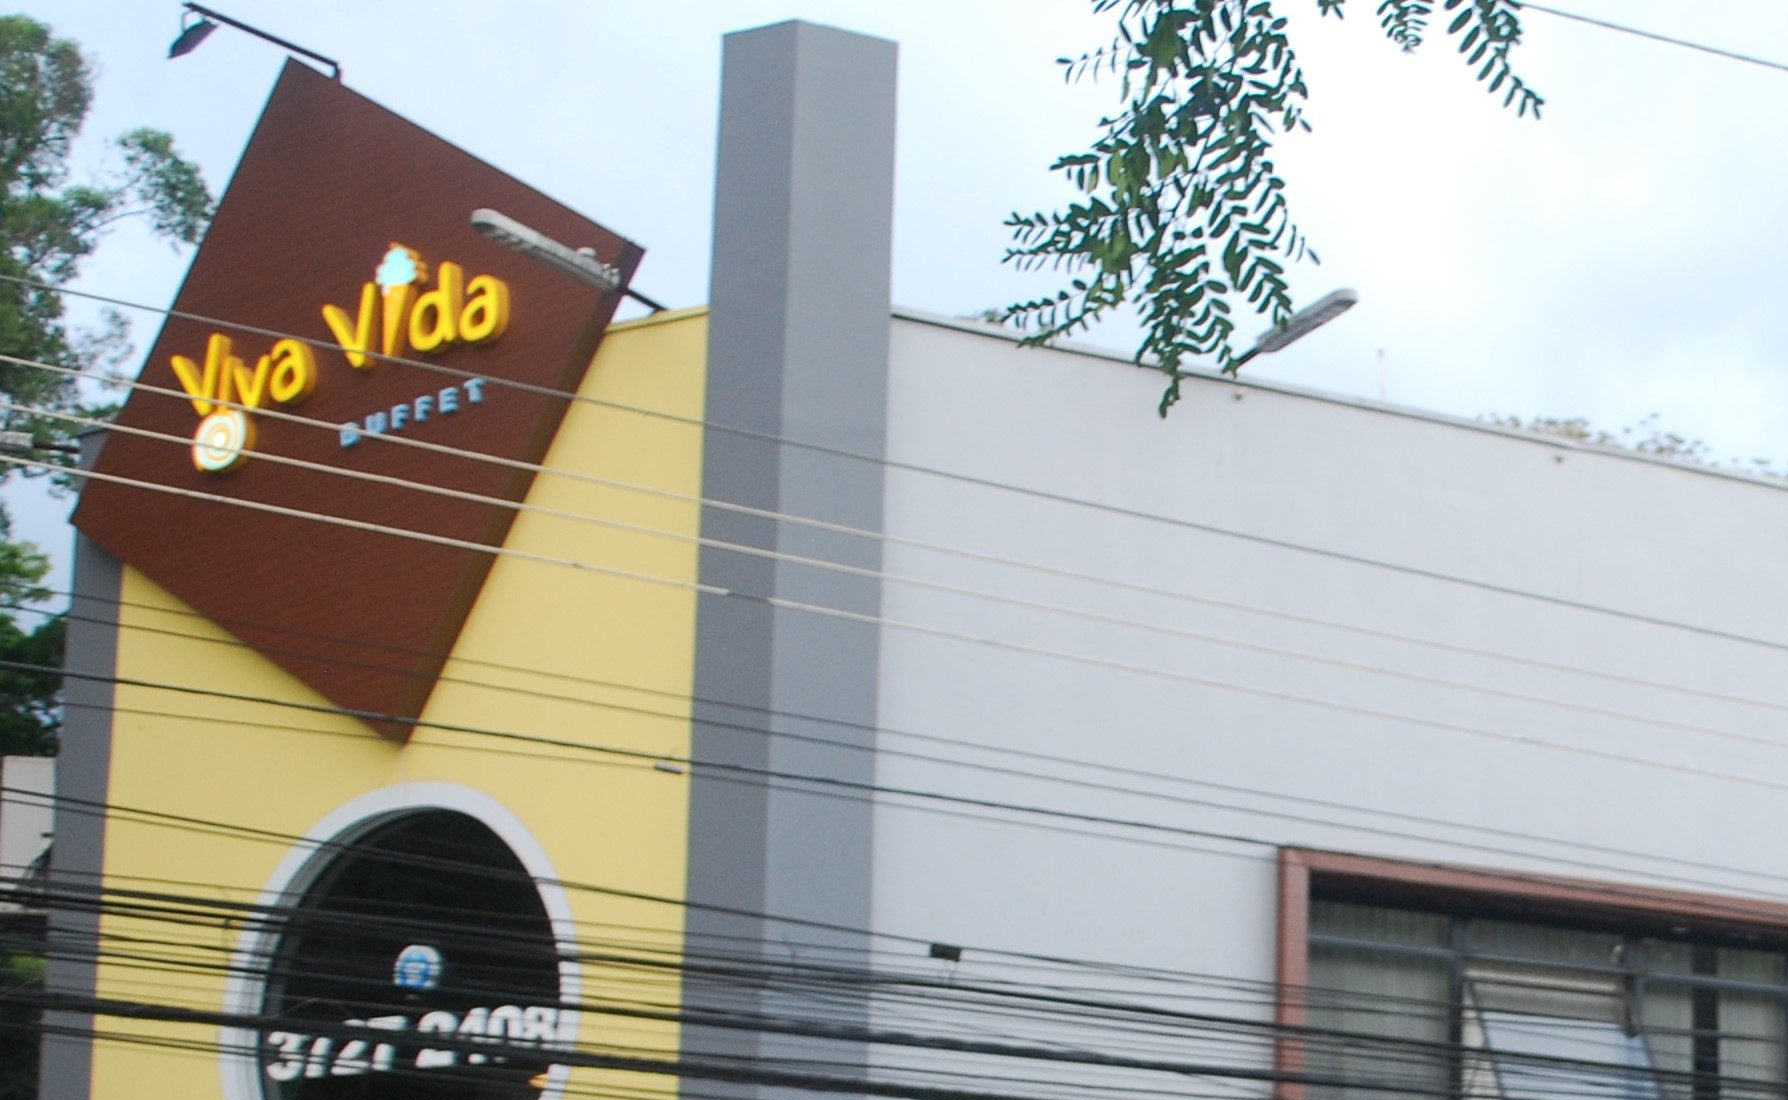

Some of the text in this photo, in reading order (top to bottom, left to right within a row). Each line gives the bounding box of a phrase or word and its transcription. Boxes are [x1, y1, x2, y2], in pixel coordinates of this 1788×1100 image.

[170, 240, 510, 471] Viva Vida
[340, 377, 486, 447] BUFFET
